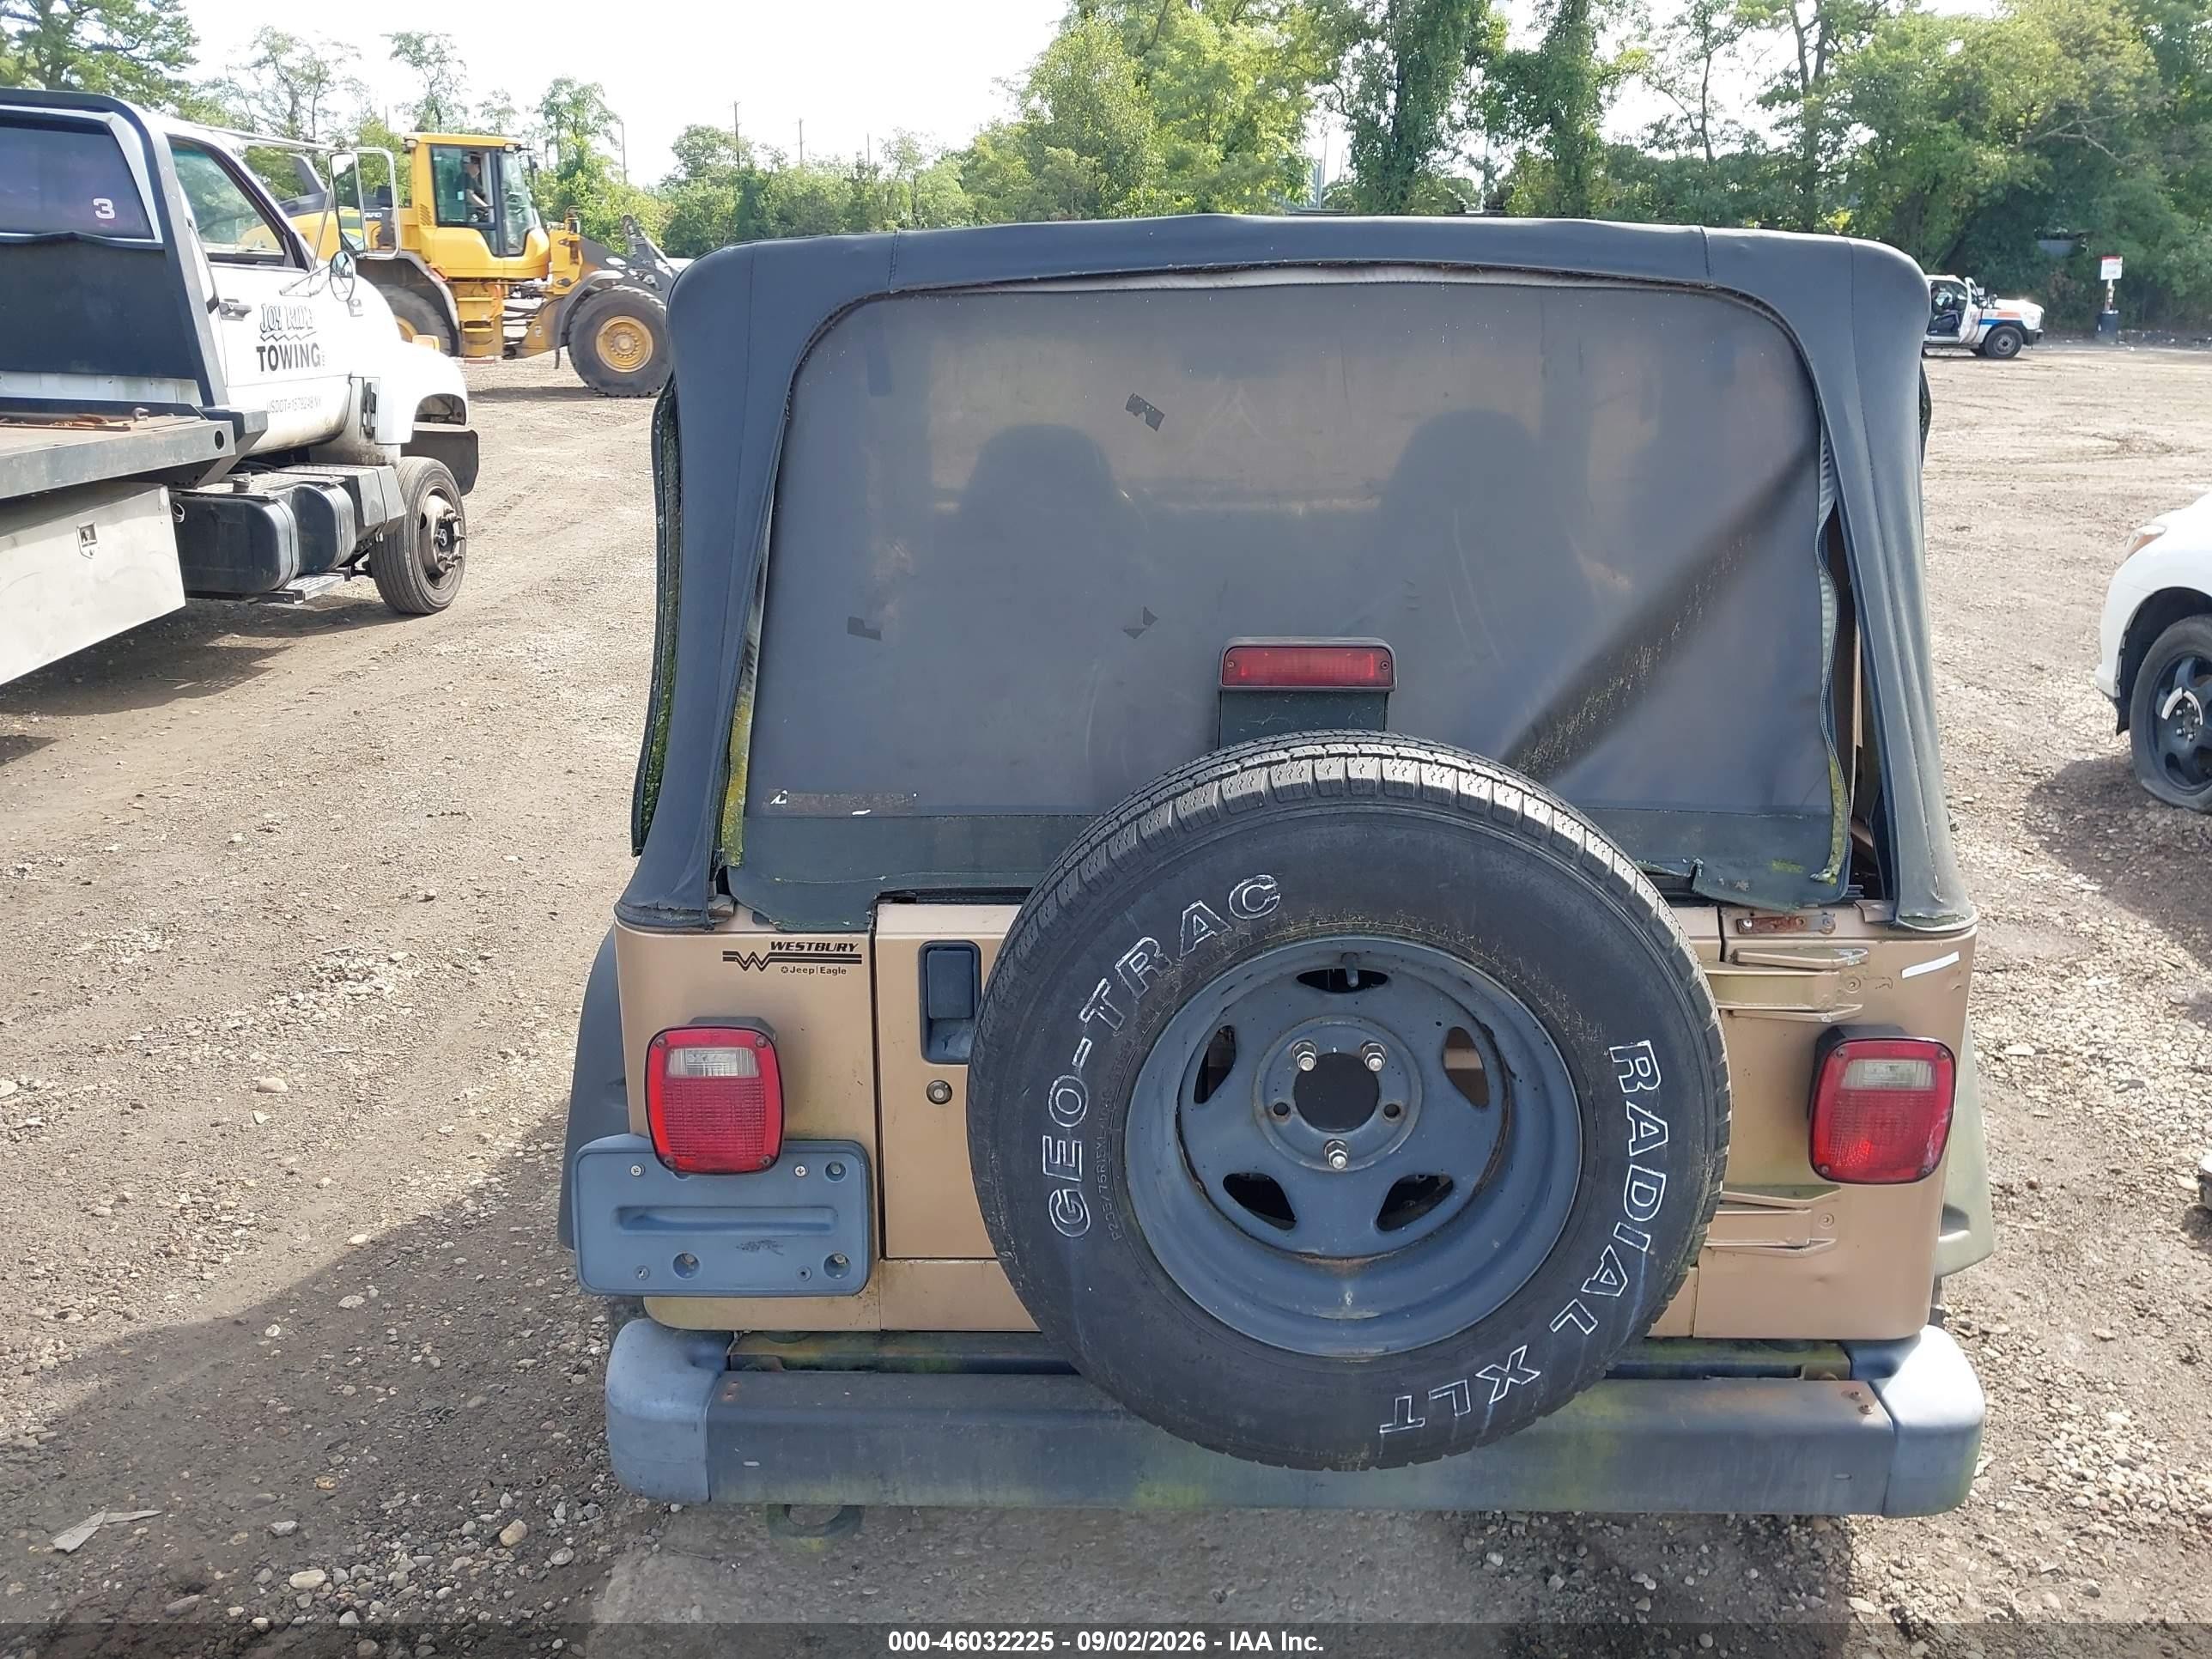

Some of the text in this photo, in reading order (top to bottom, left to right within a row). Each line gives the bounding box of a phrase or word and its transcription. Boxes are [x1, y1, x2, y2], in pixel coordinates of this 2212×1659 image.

[93, 198, 116, 219] 3
[260, 303, 282, 333] JOY
[256, 343, 321, 372] TOWING
[770, 941, 859, 952] WESTBURY
[1042, 873, 1281, 1238] GEO-TRAC
[1379, 1039, 1669, 1435] RADIAL XLT
